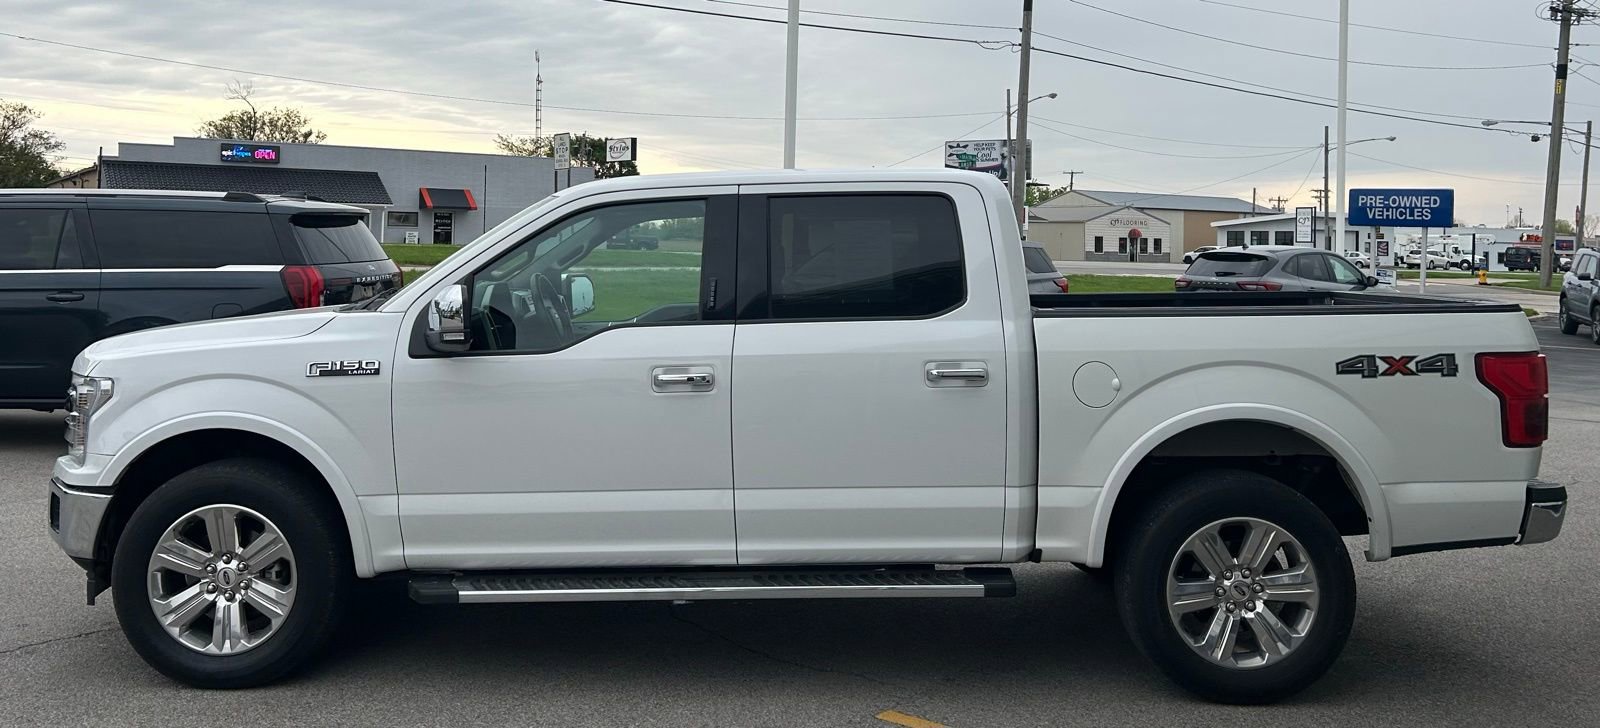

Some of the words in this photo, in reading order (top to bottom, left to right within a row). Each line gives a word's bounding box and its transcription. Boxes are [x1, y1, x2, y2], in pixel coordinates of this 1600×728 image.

[254, 150, 276, 160] OPEN
[976, 151, 993, 159] Cool
[1358, 196, 1440, 208] PRE-OWNED
[1366, 208, 1432, 220] VEHICLES
